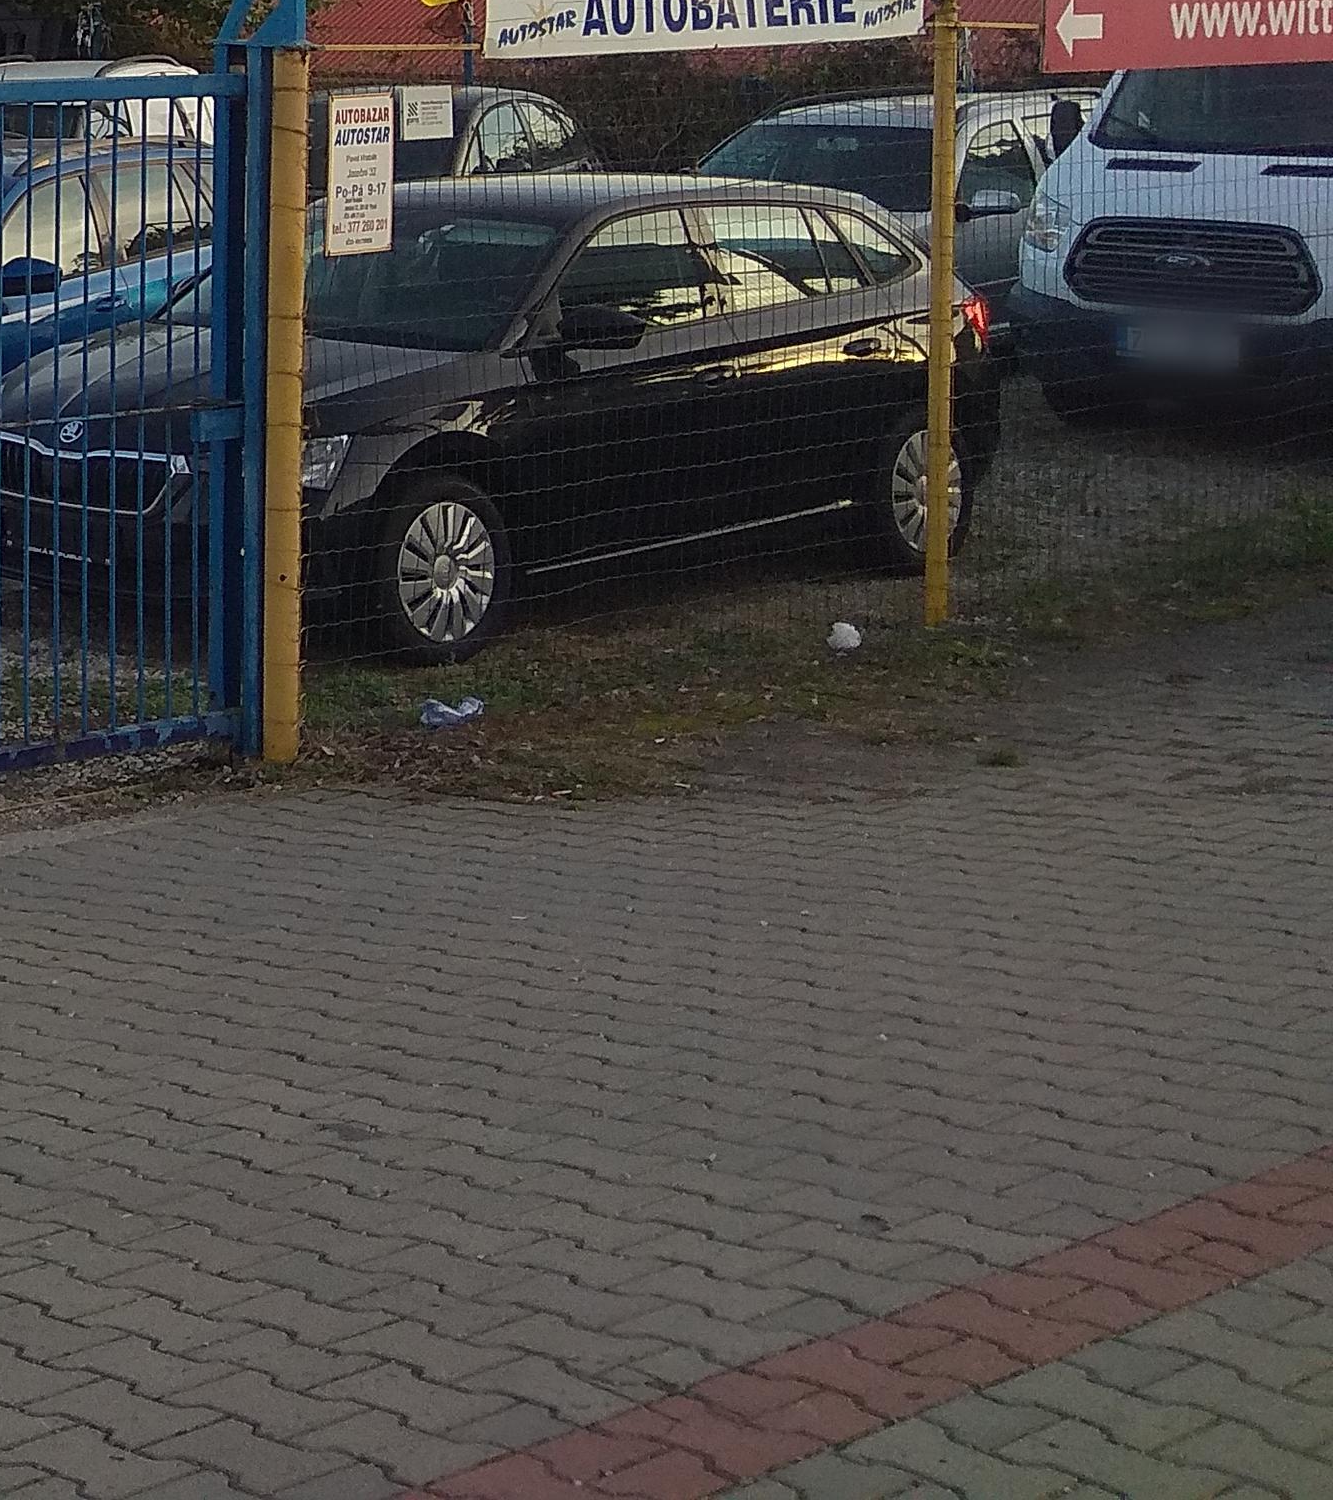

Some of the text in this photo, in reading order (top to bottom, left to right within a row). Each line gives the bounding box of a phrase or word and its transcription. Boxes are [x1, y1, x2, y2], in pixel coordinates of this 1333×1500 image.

[497, 9, 577, 48] AUTOSTAR
[335, 106, 390, 126] AUTOBAZAR
[334, 126, 390, 147] AUTOSTAR
[336, 182, 386, 198] Po-Pá 9-17
